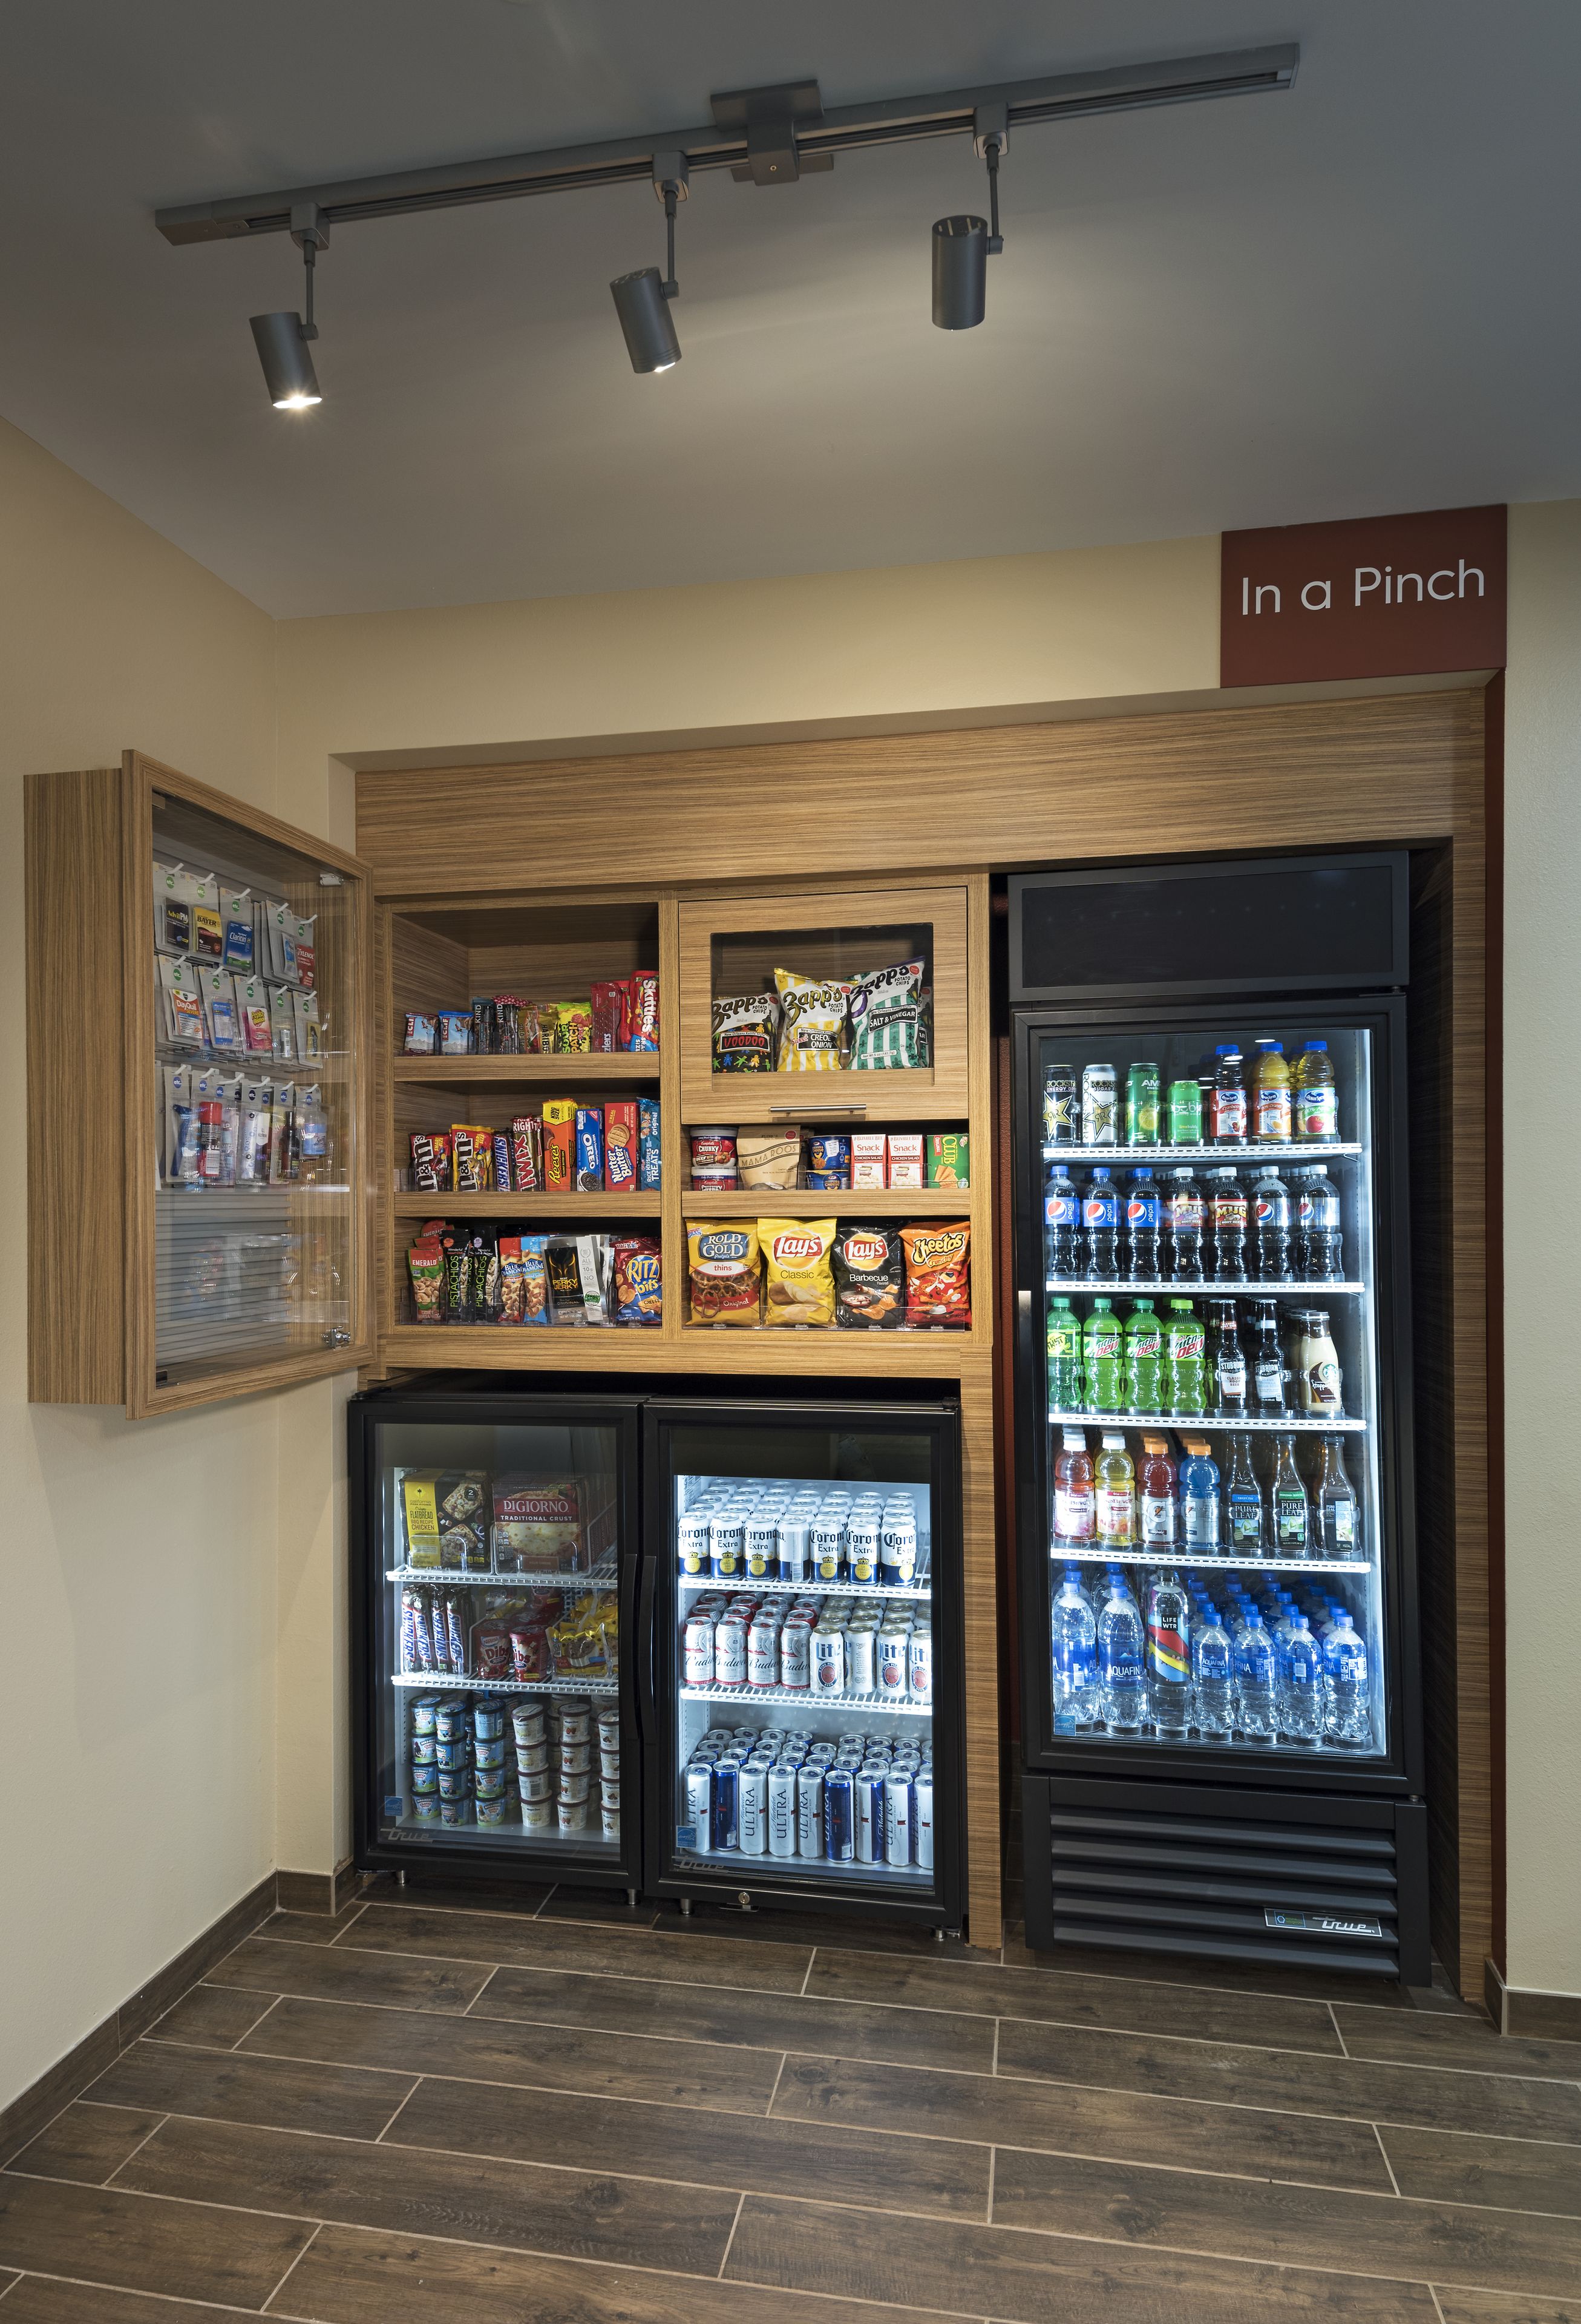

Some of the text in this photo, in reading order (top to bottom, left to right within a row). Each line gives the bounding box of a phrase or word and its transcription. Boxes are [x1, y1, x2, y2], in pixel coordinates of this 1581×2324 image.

[1243, 559, 1484, 615] In a Pinch
[197, 915, 217, 926] BAYER
[230, 932, 246, 943] Claritin
[298, 948, 315, 959] TYLENOL
[177, 1000, 197, 1010] DayQuil
[641, 979, 656, 1032] Skittles
[784, 987, 842, 1030] Zapp's
[869, 1017, 884, 1028] SALT
[889, 1011, 915, 1020] VINEGAR
[562, 1023, 571, 1053] SOUR
[569, 1022, 581, 1053] PATCH
[724, 1036, 765, 1048] VOODOO
[456, 1132, 478, 1191] m&m's
[583, 1134, 595, 1169] OREO
[615, 1146, 632, 1177] Butter
[741, 1145, 796, 1167] MAMA ROOS
[942, 1137, 957, 1164] CLUB
[414, 1135, 439, 1191] m&m's
[494, 1138, 509, 1187] SNICKERS
[514, 1134, 537, 1191] TWIX
[548, 1144, 561, 1184] Reese's
[607, 1151, 624, 1183] Nutter
[650, 1149, 659, 1181] TREATS
[1216, 1205, 1246, 1217] MUG
[708, 1233, 742, 1245] ROLD
[776, 1236, 819, 1258] Lay's
[913, 1233, 964, 1263] Cheetos
[702, 1244, 744, 1258] GOLD
[848, 1241, 883, 1261] Lay's
[928, 1253, 954, 1267] Crunchy
[450, 1255, 459, 1307] PISTACHIOS
[476, 1256, 487, 1307] PISTACHIOS
[502, 1267, 522, 1276] DIAMOND
[628, 1259, 657, 1282] RITZ
[781, 1270, 814, 1279] Classic
[849, 1274, 888, 1282] Barbecue
[635, 1280, 658, 1293] bits
[723, 1298, 749, 1308] Original
[410, 1511, 433, 1519] FLATBREAD
[503, 1501, 568, 1512] DIGIORNO
[1148, 1501, 1166, 1523] G
[854, 1545, 874, 1554] Extra
[816, 1642, 841, 1661] Lite
[880, 1641, 905, 1662] Lite
[1202, 1658, 1225, 1667] AQUAFINA
[745, 1787, 754, 1837] ULTRA
[777, 1789, 787, 1839] ULTRA
[800, 1790, 808, 1839] ULTRA
[1312, 1916, 1372, 1933] true
